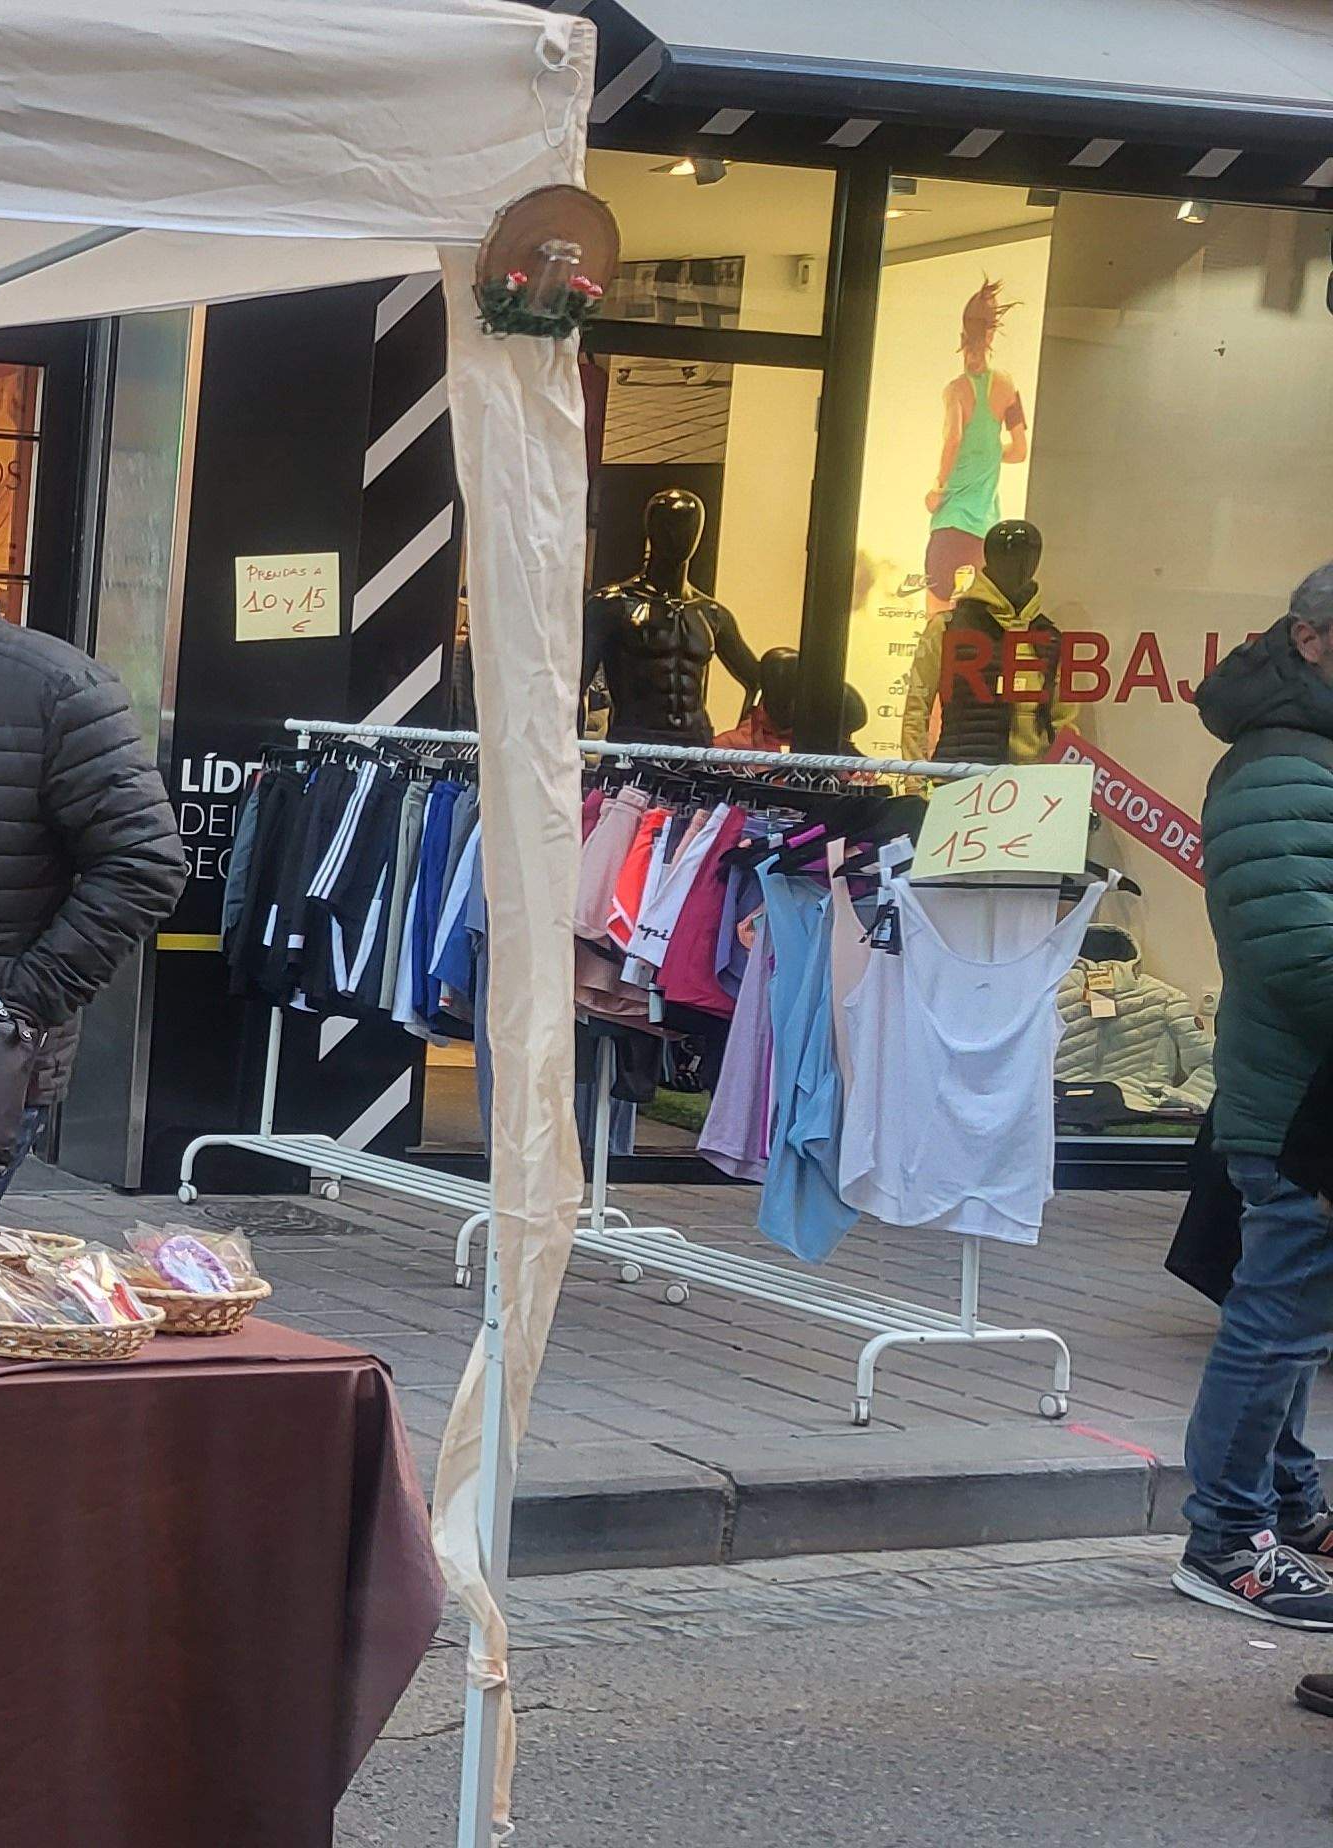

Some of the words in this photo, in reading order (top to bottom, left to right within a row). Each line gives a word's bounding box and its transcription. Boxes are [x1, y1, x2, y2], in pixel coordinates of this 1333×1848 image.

[242, 590, 277, 613] 10
[298, 586, 327, 613] 15
[292, 620, 311, 632] €
[941, 629, 1268, 704] REBAJ
[954, 779, 1019, 819] 10
[1061, 745, 1164, 835] PECIOS
[1160, 820, 1201, 862] DE
